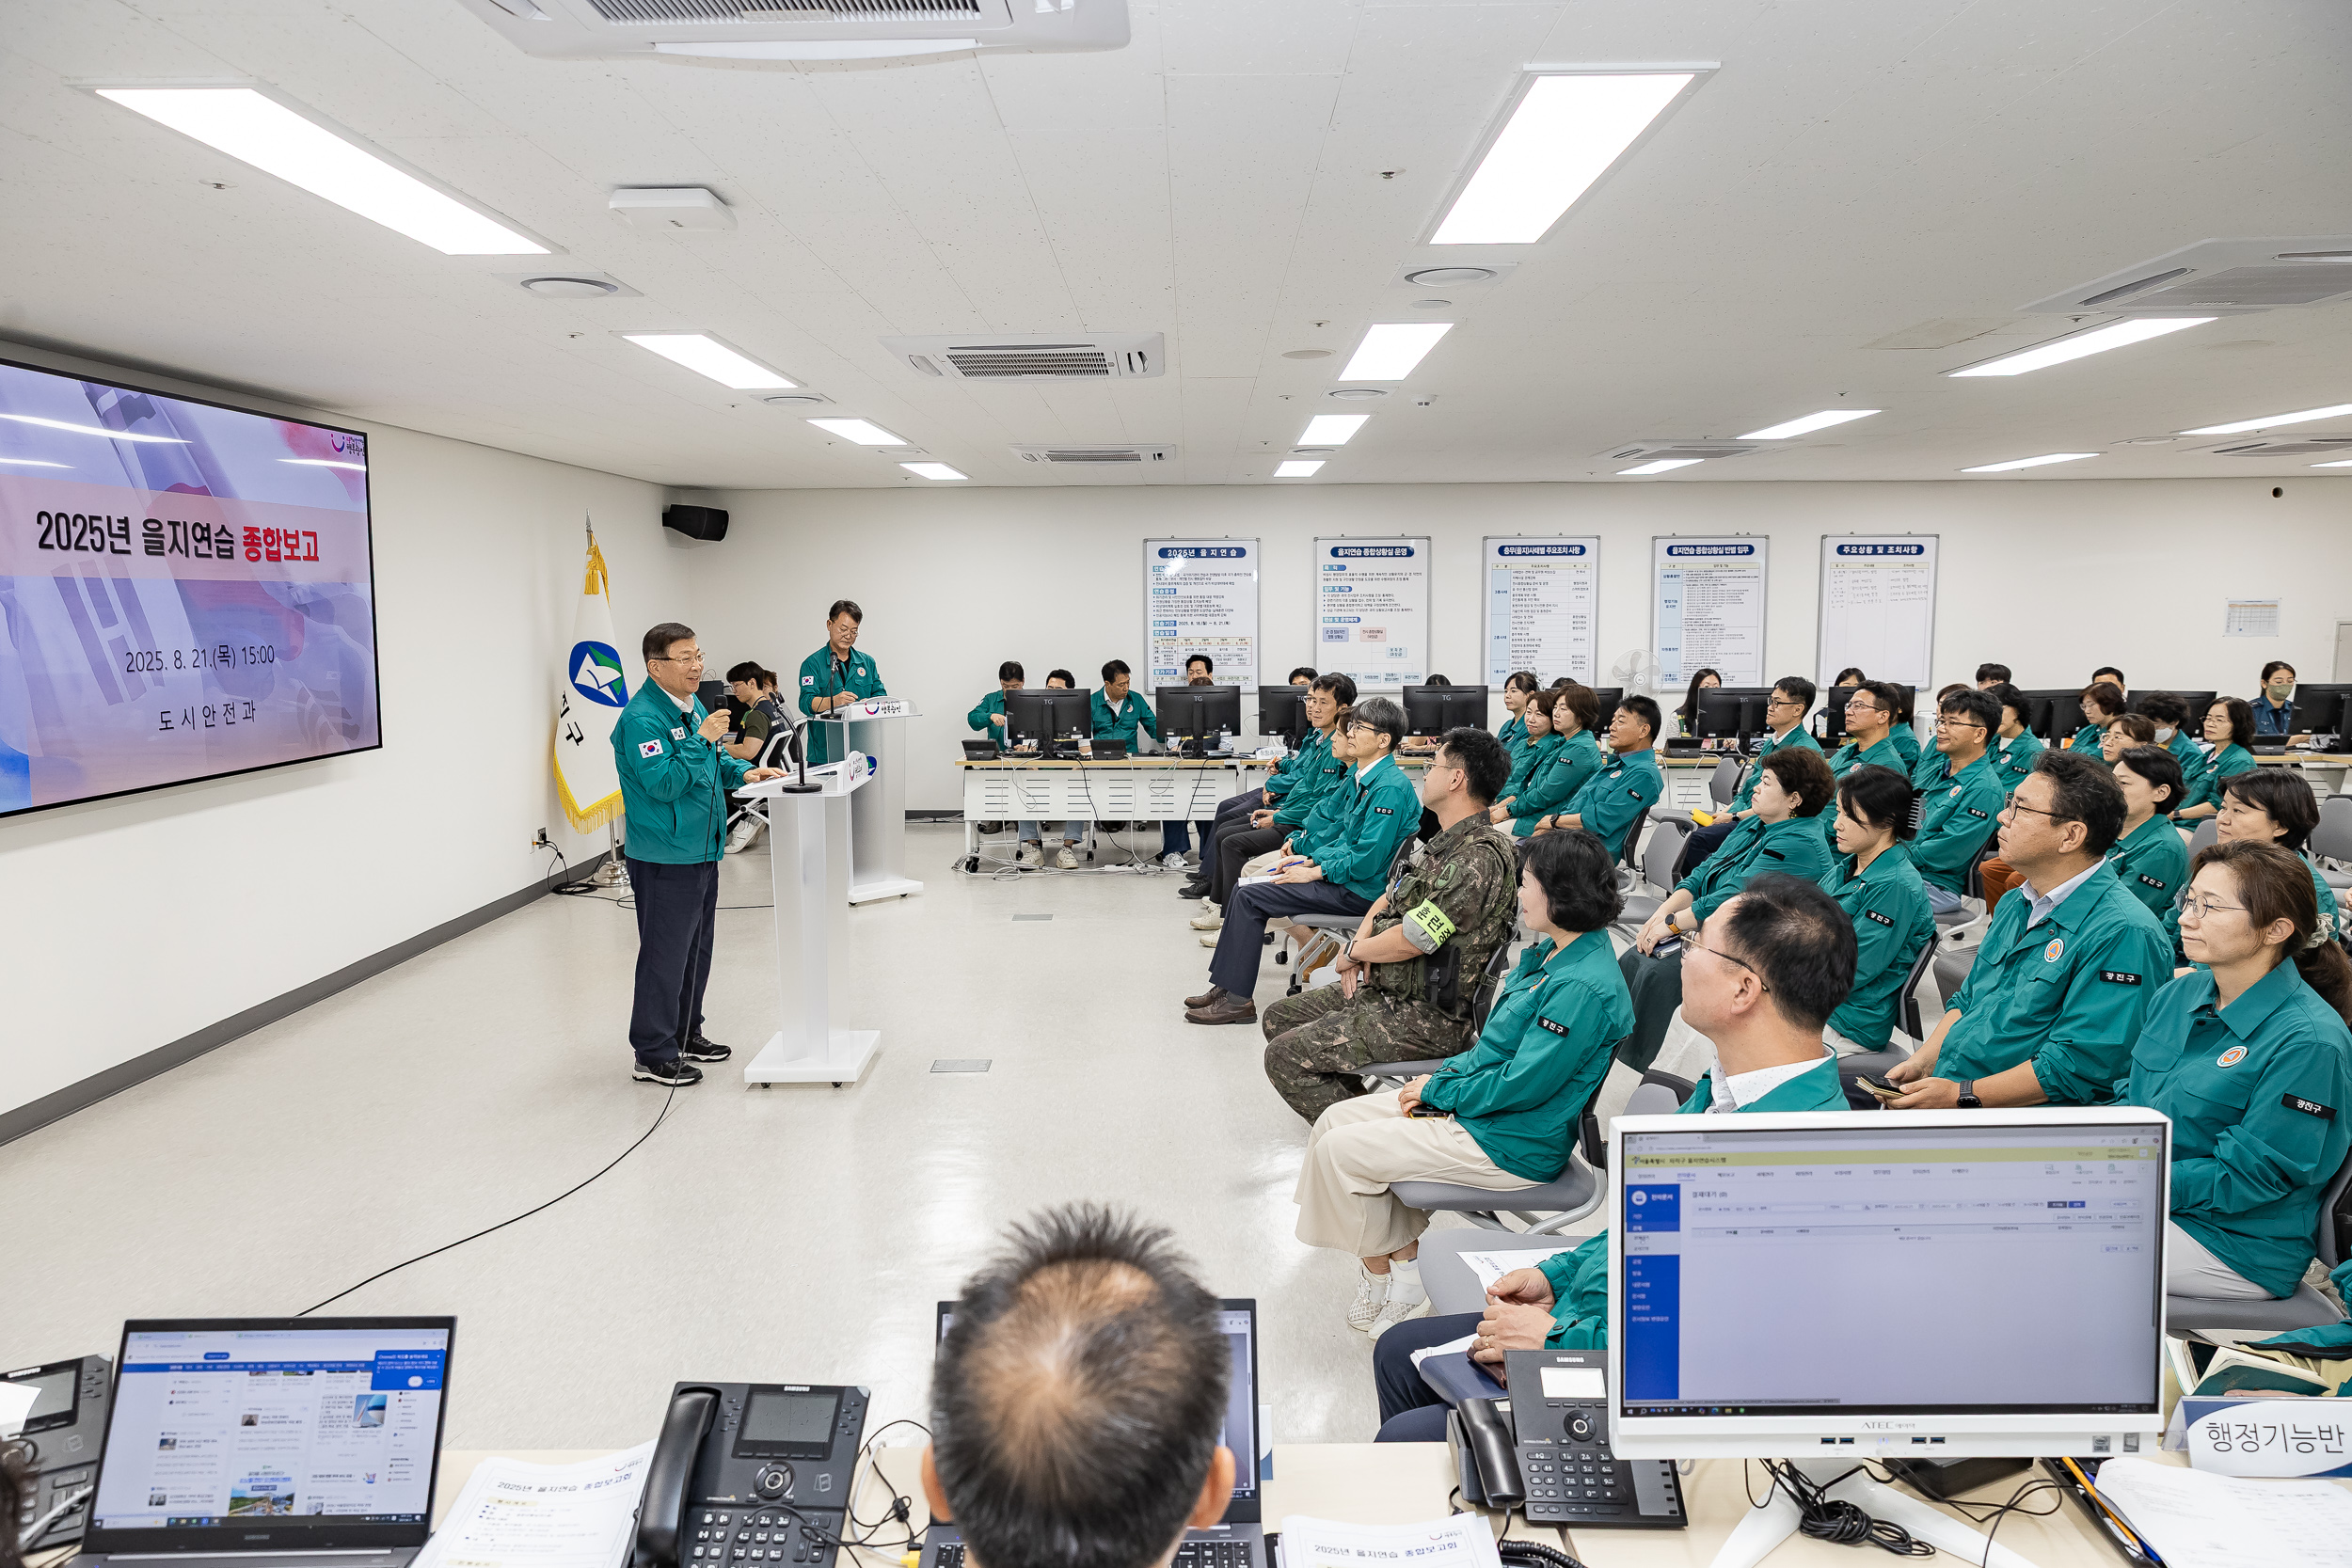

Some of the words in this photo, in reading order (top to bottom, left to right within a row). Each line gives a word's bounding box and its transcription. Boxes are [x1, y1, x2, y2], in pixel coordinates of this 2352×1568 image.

[37, 511, 132, 555] 2025년
[142, 518, 234, 560] 을지연습
[243, 525, 319, 562] 종합보고
[1672, 546, 1694, 555] 을지연습
[1738, 546, 1749, 554] 임무
[126, 651, 167, 673] 2025.
[174, 650, 186, 670] 8.
[192, 644, 236, 670] 21.(목)
[242, 645, 275, 666] 15:00
[2142, 876, 2163, 888] 광진구
[1870, 911, 1890, 925] 광진구
[2106, 971, 2135, 984] 광진구
[1543, 1019, 1564, 1034] 광진구
[2296, 1098, 2322, 1114] 광진구
[2206, 1421, 2344, 1453] 행정기능반
[498, 1481, 532, 1493] 2025년
[537, 1484, 578, 1493] 을지연습
[584, 1472, 632, 1491] 종합보고회
[1314, 1544, 1350, 1556] 2025년
[1357, 1549, 1398, 1559] 을지연습
[1405, 1542, 1457, 1557] 종합보고회
